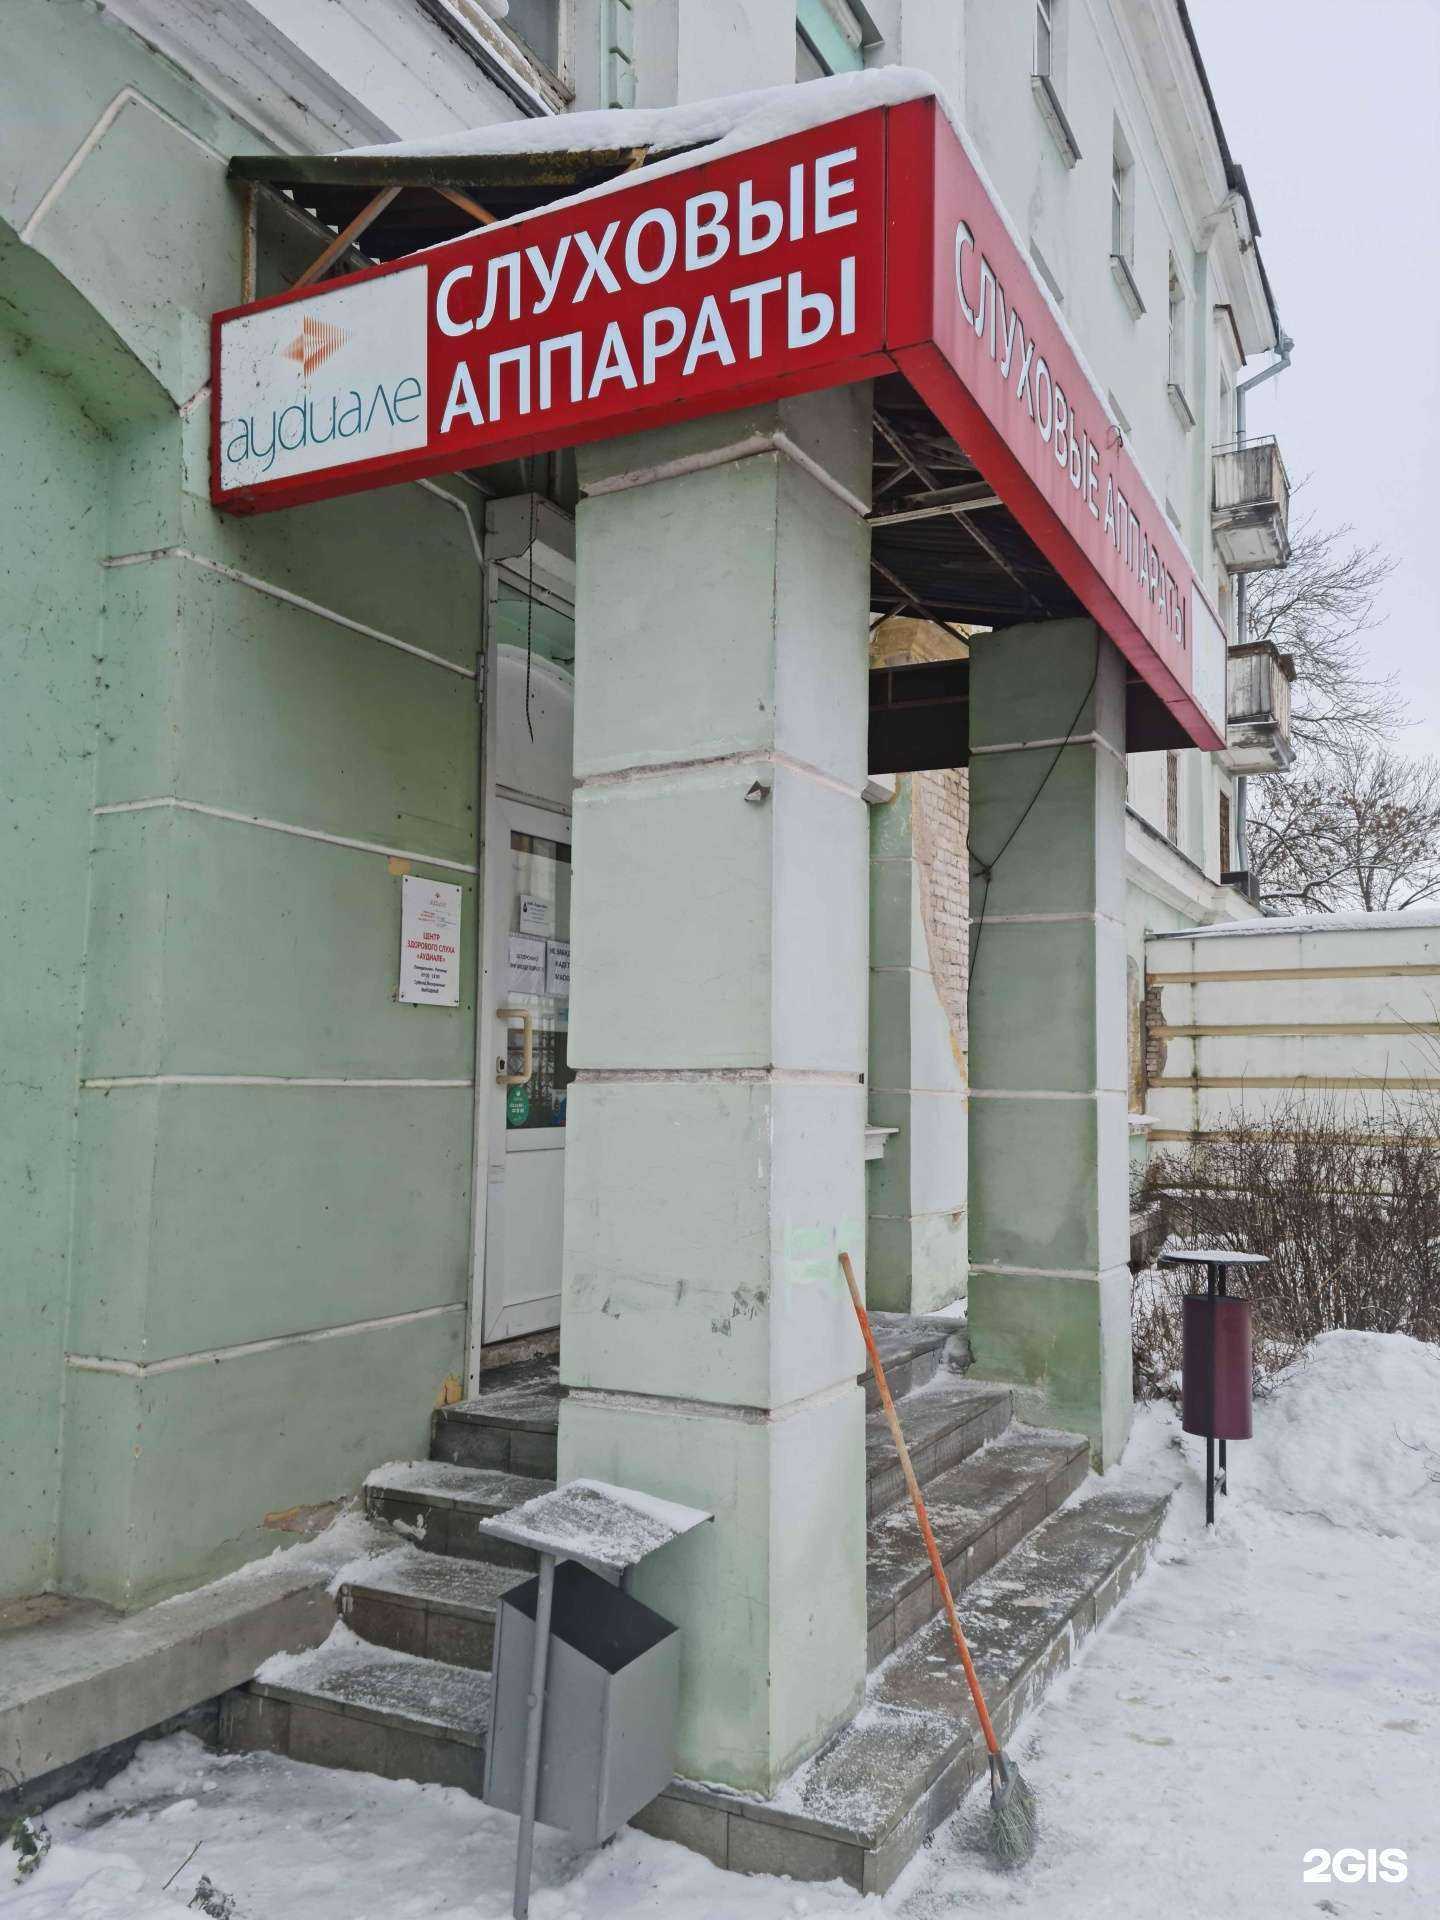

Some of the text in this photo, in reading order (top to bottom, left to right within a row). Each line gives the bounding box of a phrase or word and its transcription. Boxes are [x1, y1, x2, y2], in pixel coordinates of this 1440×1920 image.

[436, 147, 858, 337] СЛУХОВЫЕ
[440, 256, 858, 434] АППАРАТЫ
[955, 219, 1187, 651] СЛУХОВЫЕ АППАРАТЫ
[407, 940, 456, 953] ЗДОРОВОГО СЛУХА
[423, 932, 441, 940] ЦЕНТР
